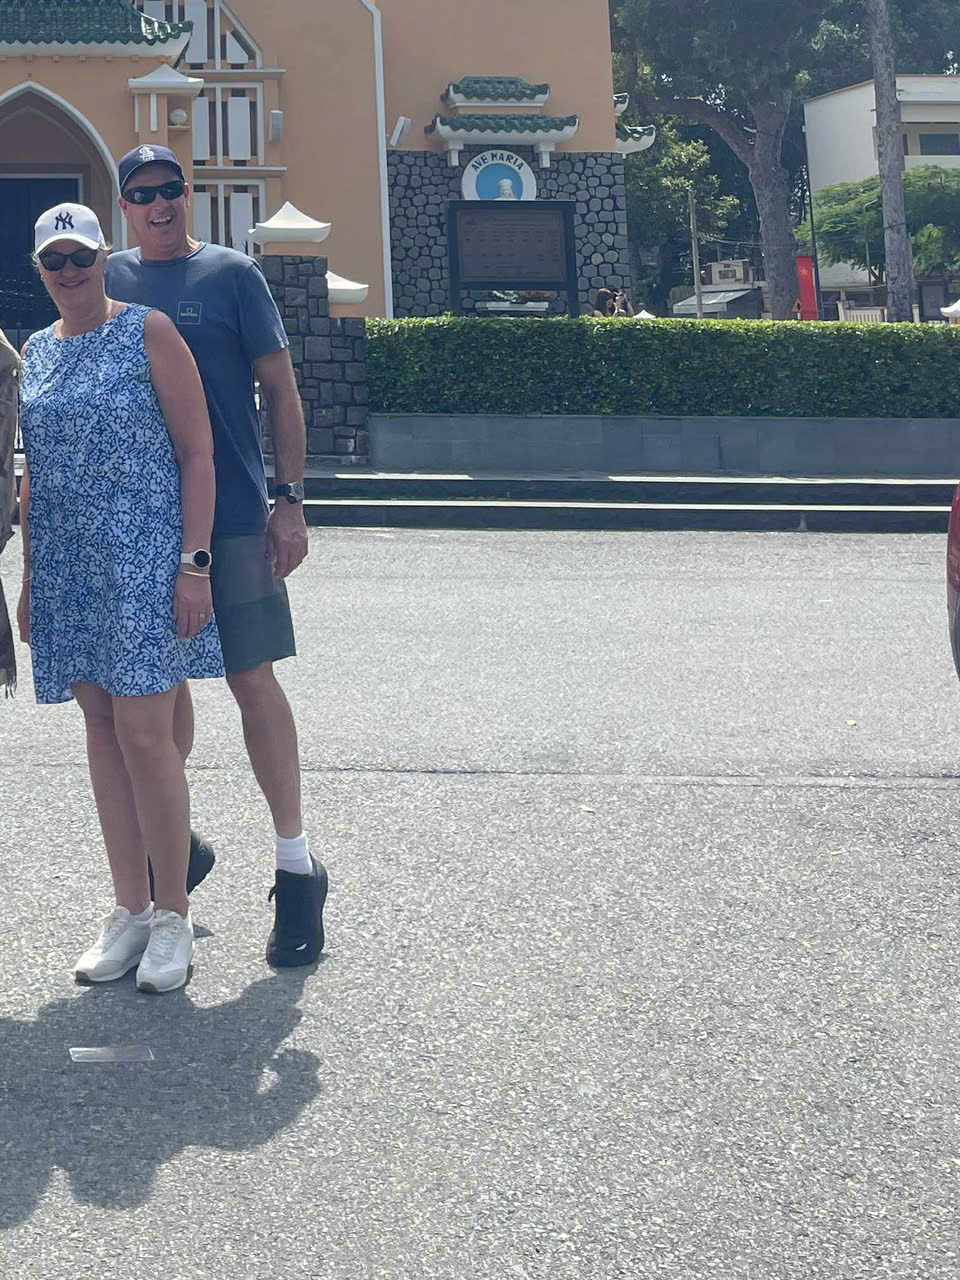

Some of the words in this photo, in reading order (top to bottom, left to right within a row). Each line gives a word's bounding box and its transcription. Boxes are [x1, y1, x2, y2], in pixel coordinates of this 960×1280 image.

[471, 154, 488, 171] AVE
[490, 152, 524, 171] MARIA
[55, 211, 74, 230] NY
